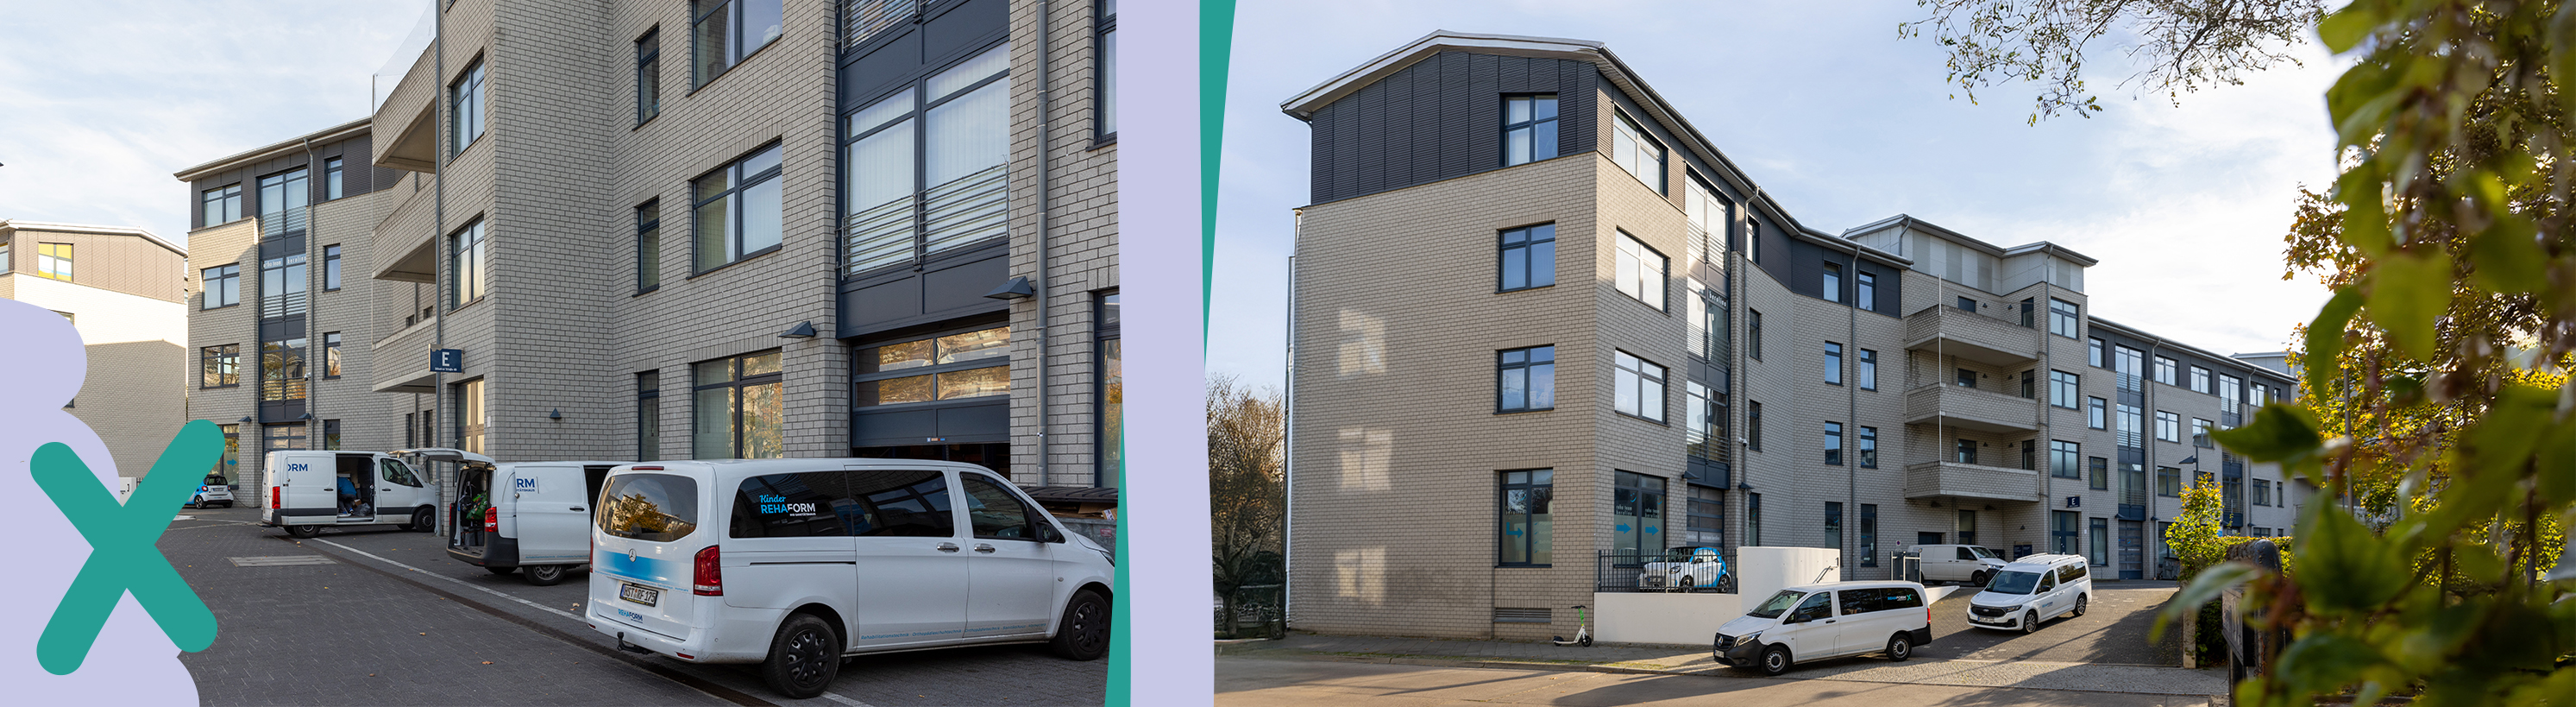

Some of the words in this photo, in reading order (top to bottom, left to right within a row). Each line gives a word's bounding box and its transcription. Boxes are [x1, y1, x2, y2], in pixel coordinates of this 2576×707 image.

[442, 351, 450, 367] E
[516, 477, 535, 489] RM
[759, 494, 786, 503] Kinder
[760, 503, 816, 514] REHAFORM
[644, 590, 656, 603] 175
[618, 609, 643, 621] REHAFORM
